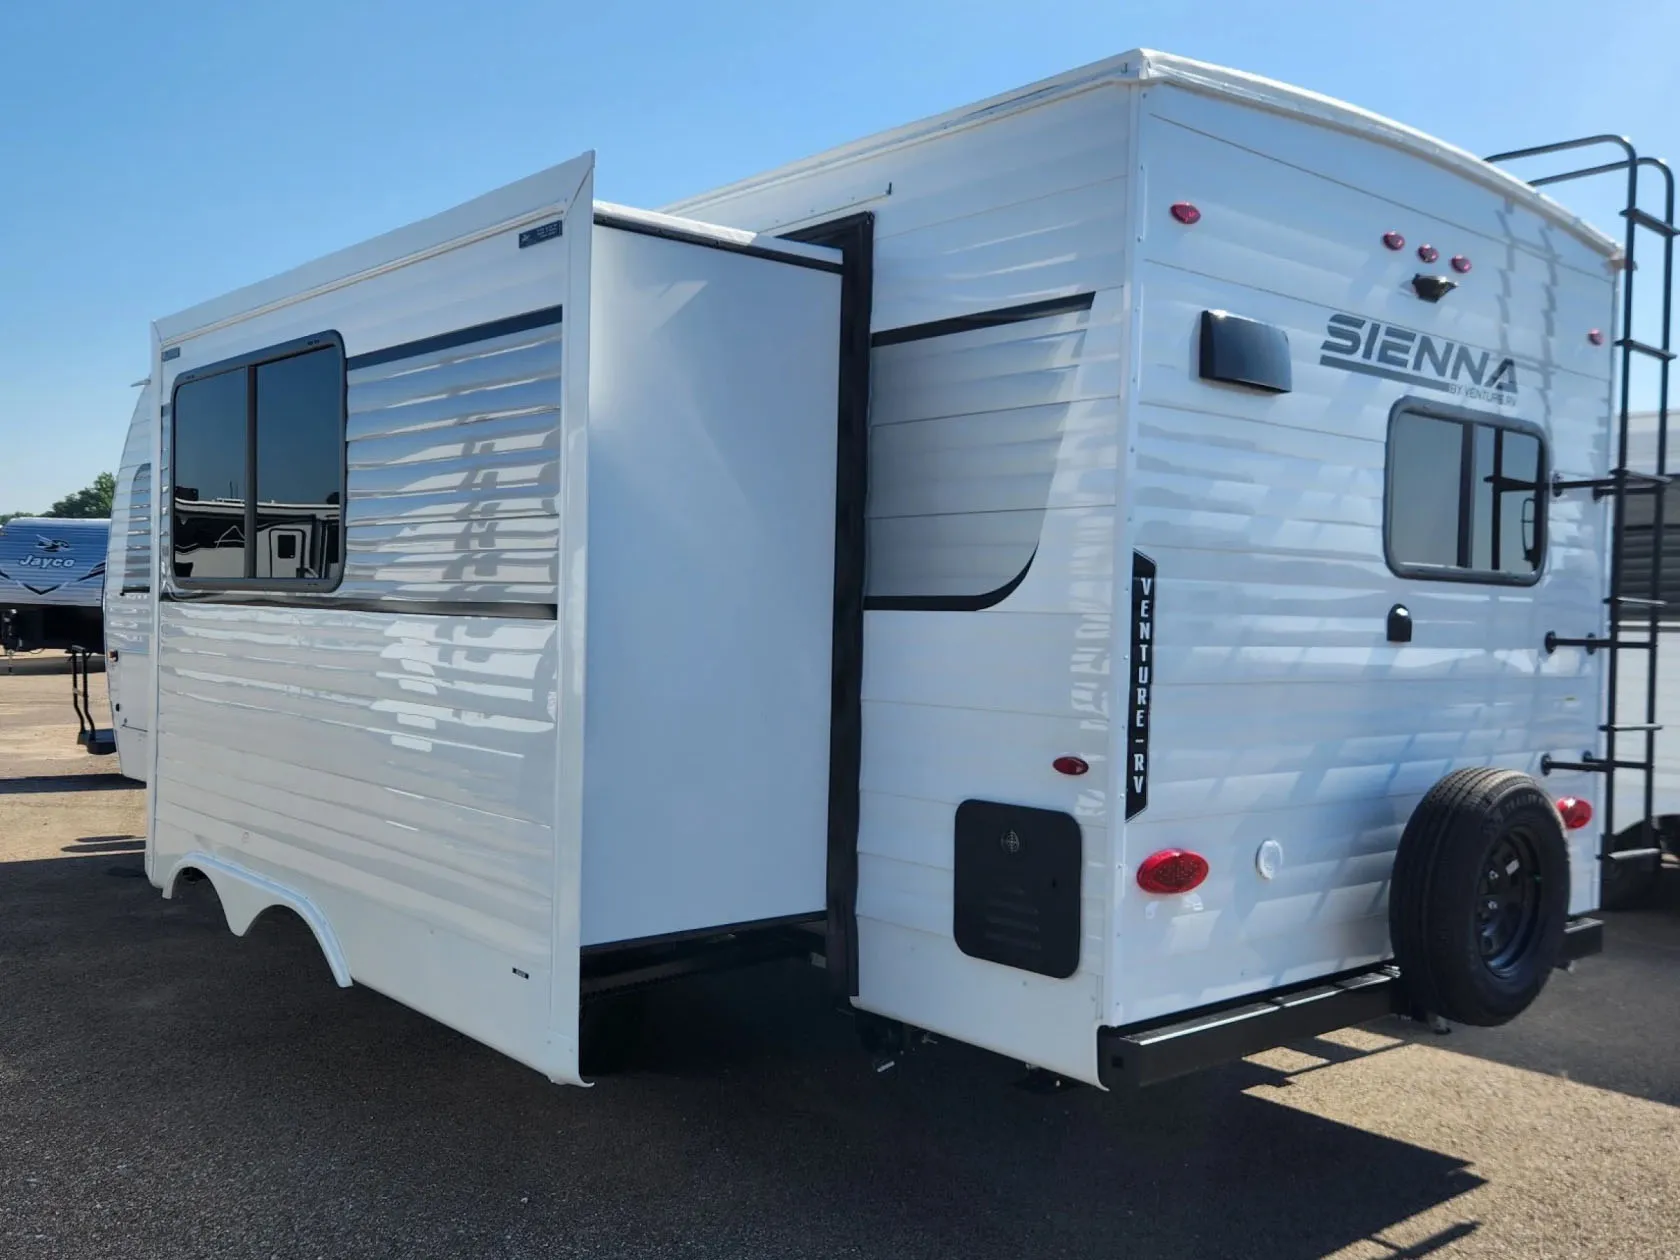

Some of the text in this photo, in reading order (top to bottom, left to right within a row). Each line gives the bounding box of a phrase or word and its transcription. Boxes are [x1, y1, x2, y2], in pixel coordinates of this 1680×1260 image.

[1320, 313, 1518, 394] SIENNA
[1450, 384, 1463, 395] BY
[20, 554, 75, 568] Jayco
